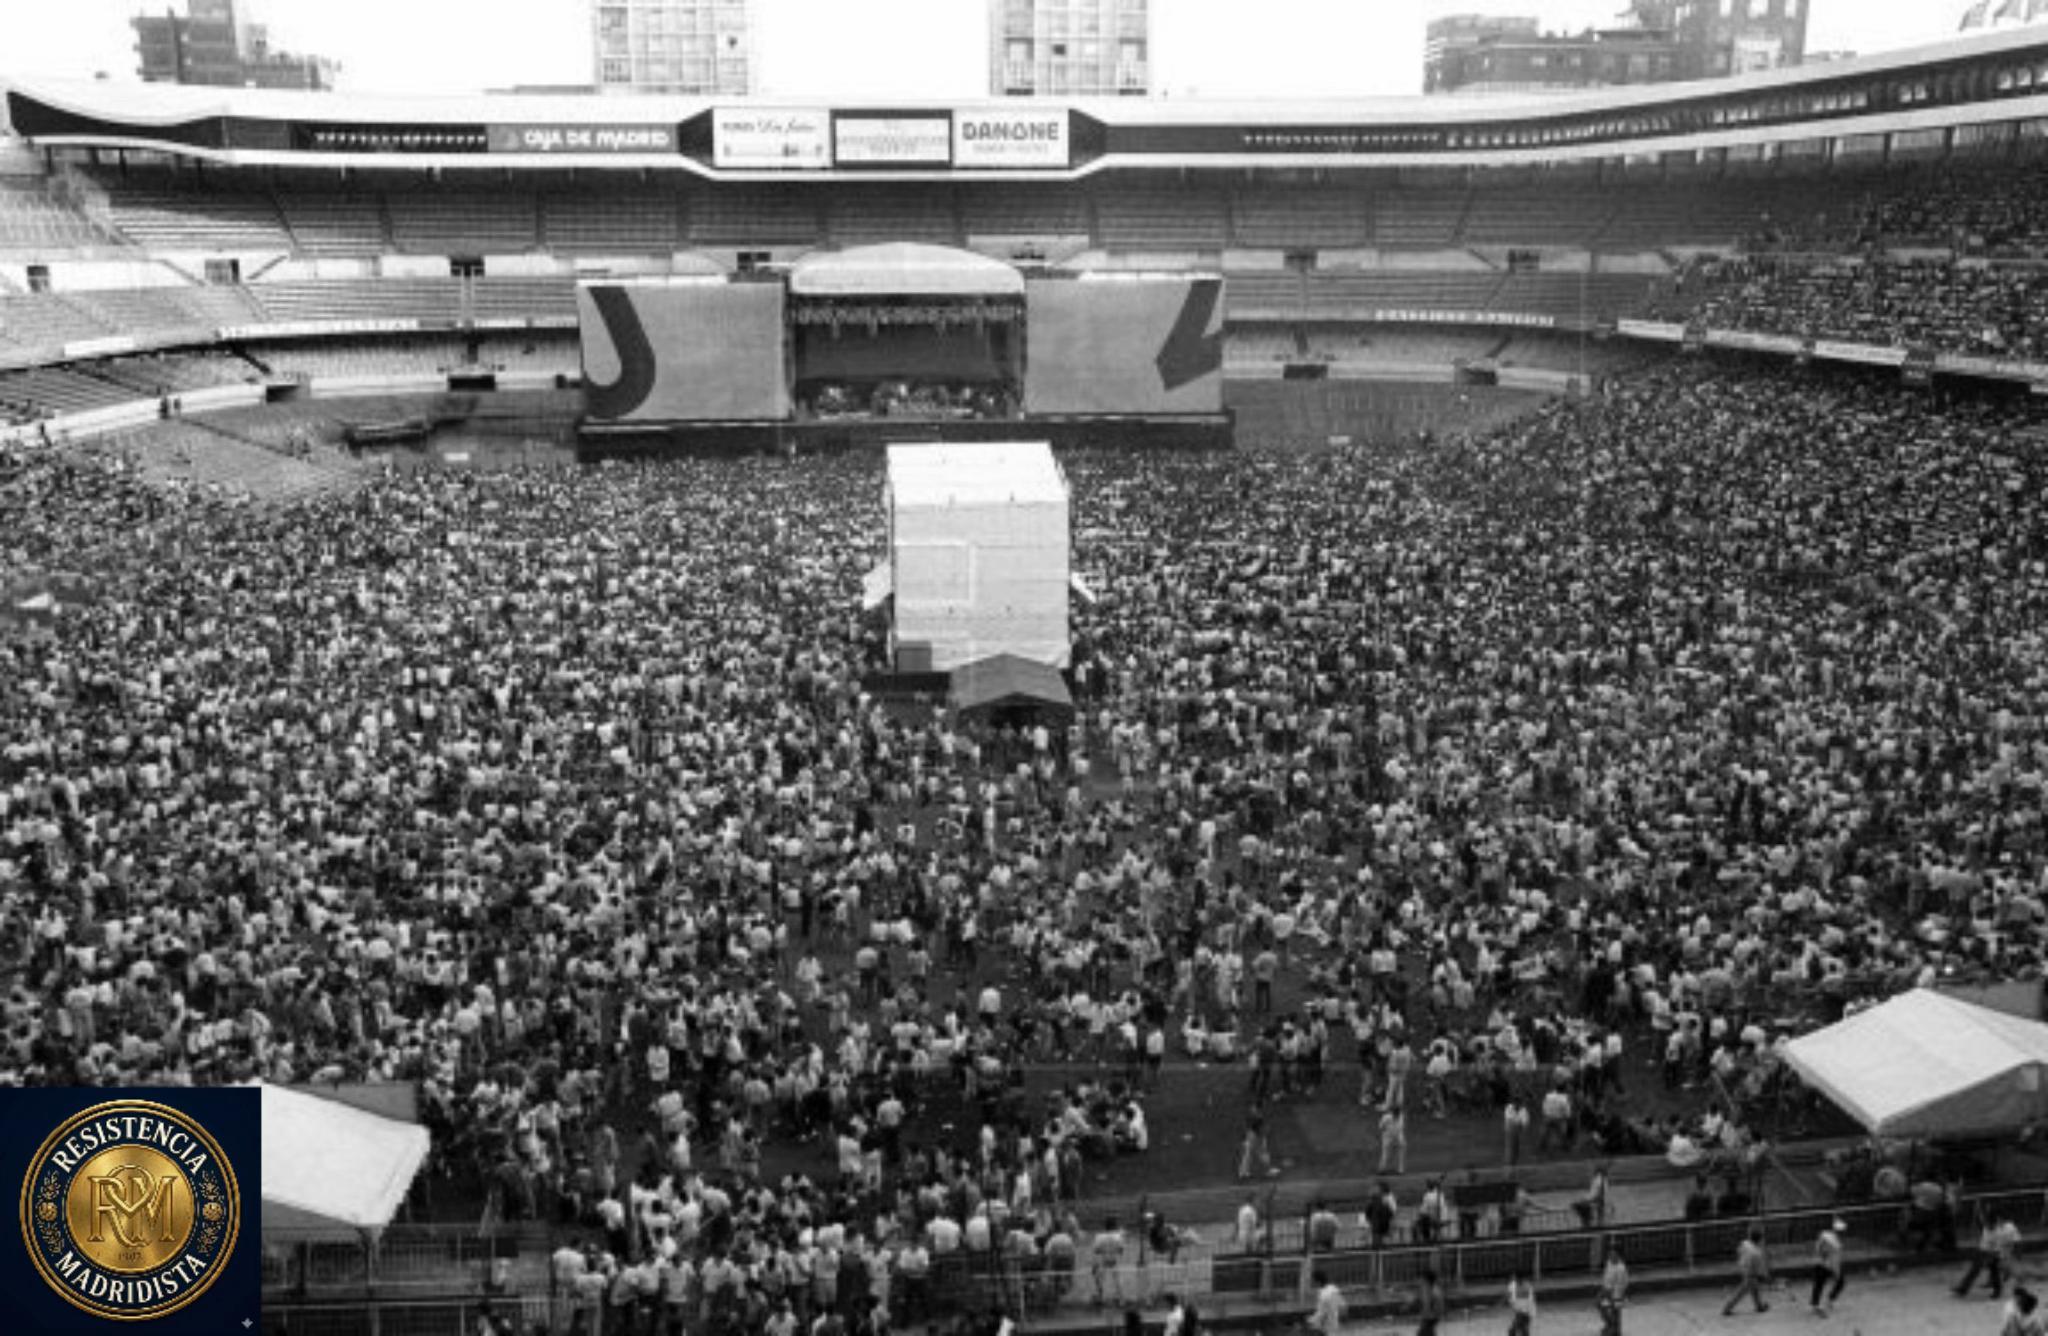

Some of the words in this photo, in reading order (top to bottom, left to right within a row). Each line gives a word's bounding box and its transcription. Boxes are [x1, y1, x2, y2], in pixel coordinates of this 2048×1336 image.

[566, 129, 591, 147] DE
[596, 128, 670, 150] MADRID
[962, 121, 1059, 140] DANONE
